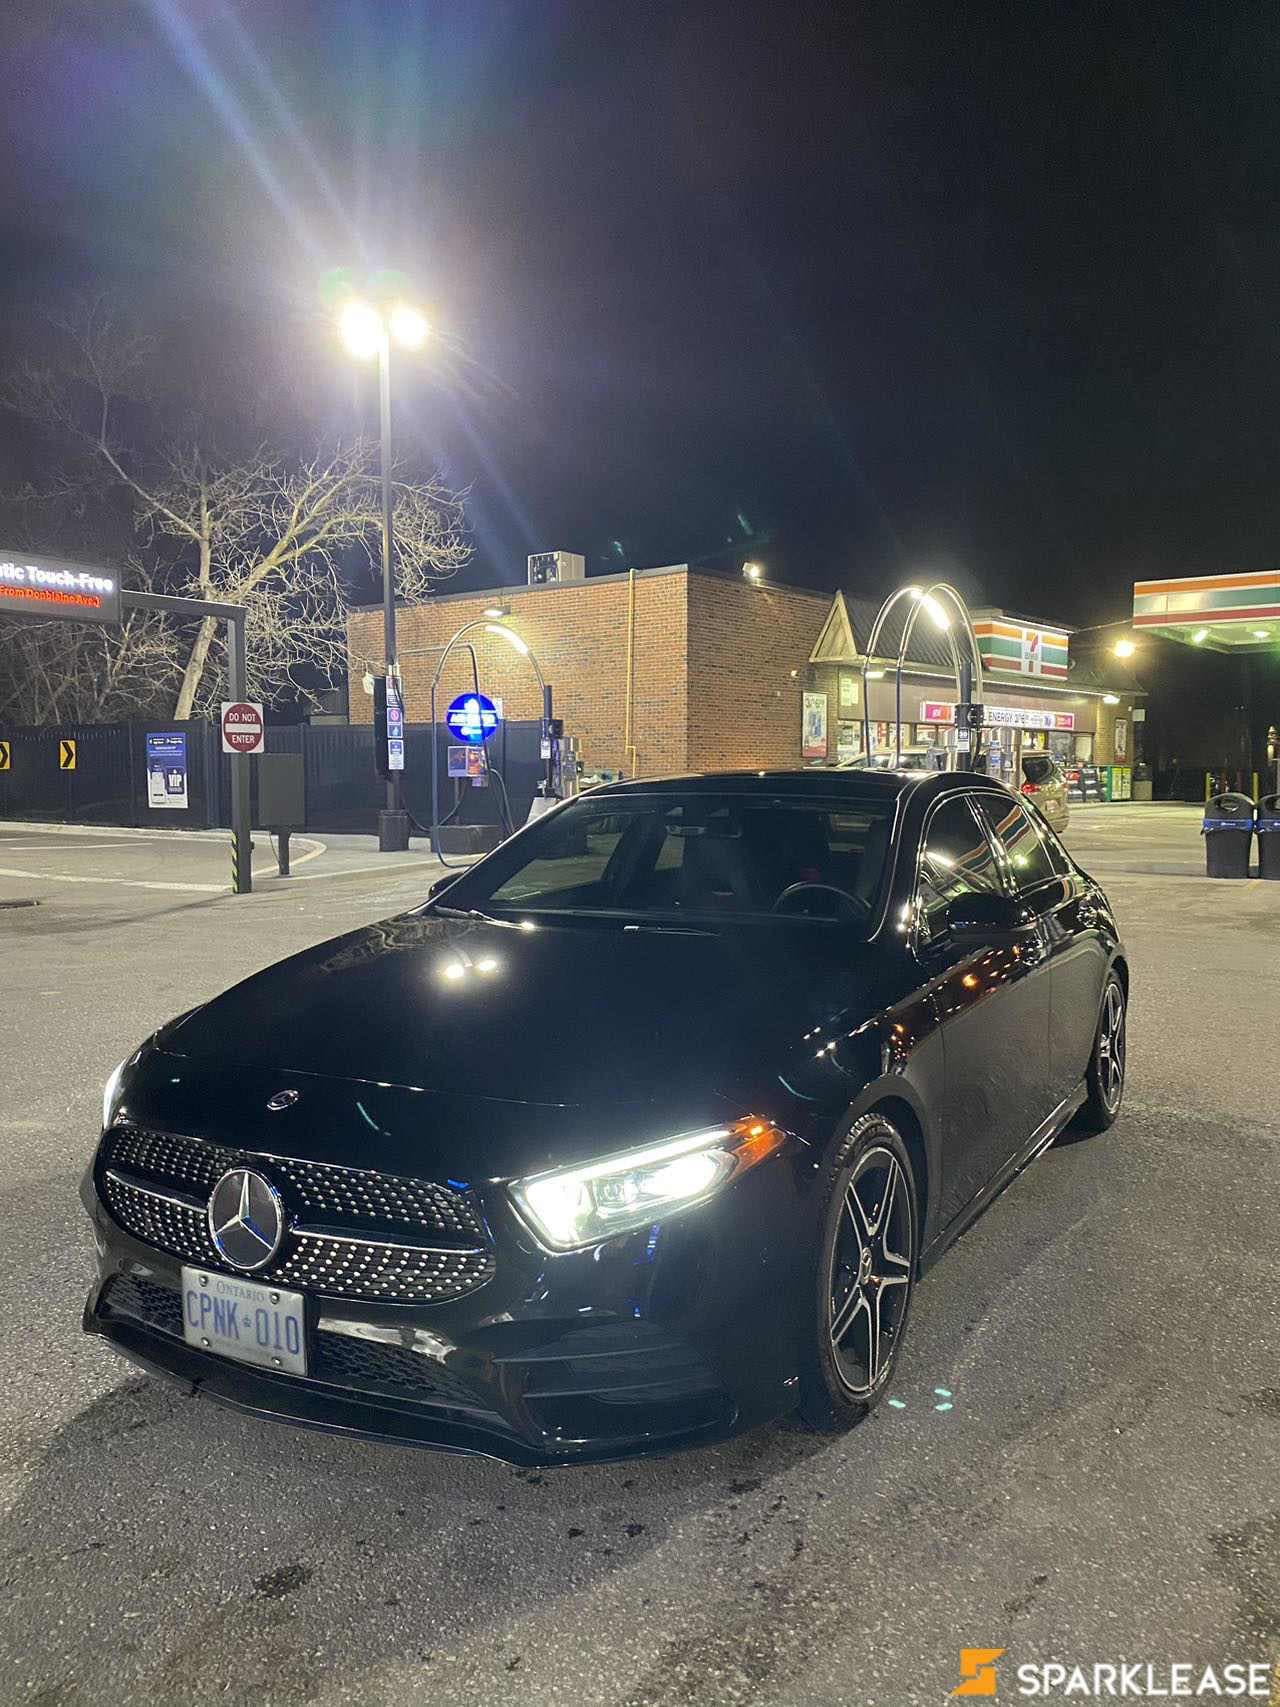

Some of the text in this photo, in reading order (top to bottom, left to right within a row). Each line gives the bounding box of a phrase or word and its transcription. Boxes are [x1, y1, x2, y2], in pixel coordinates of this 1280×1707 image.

[0, 585, 25, 599] From
[229, 713, 256, 722] DO NOT
[232, 734, 255, 744] ENTER
[168, 773, 182, 787] VIP
[216, 1280, 267, 1301] ONTARIO
[187, 1290, 240, 1340] CPNK
